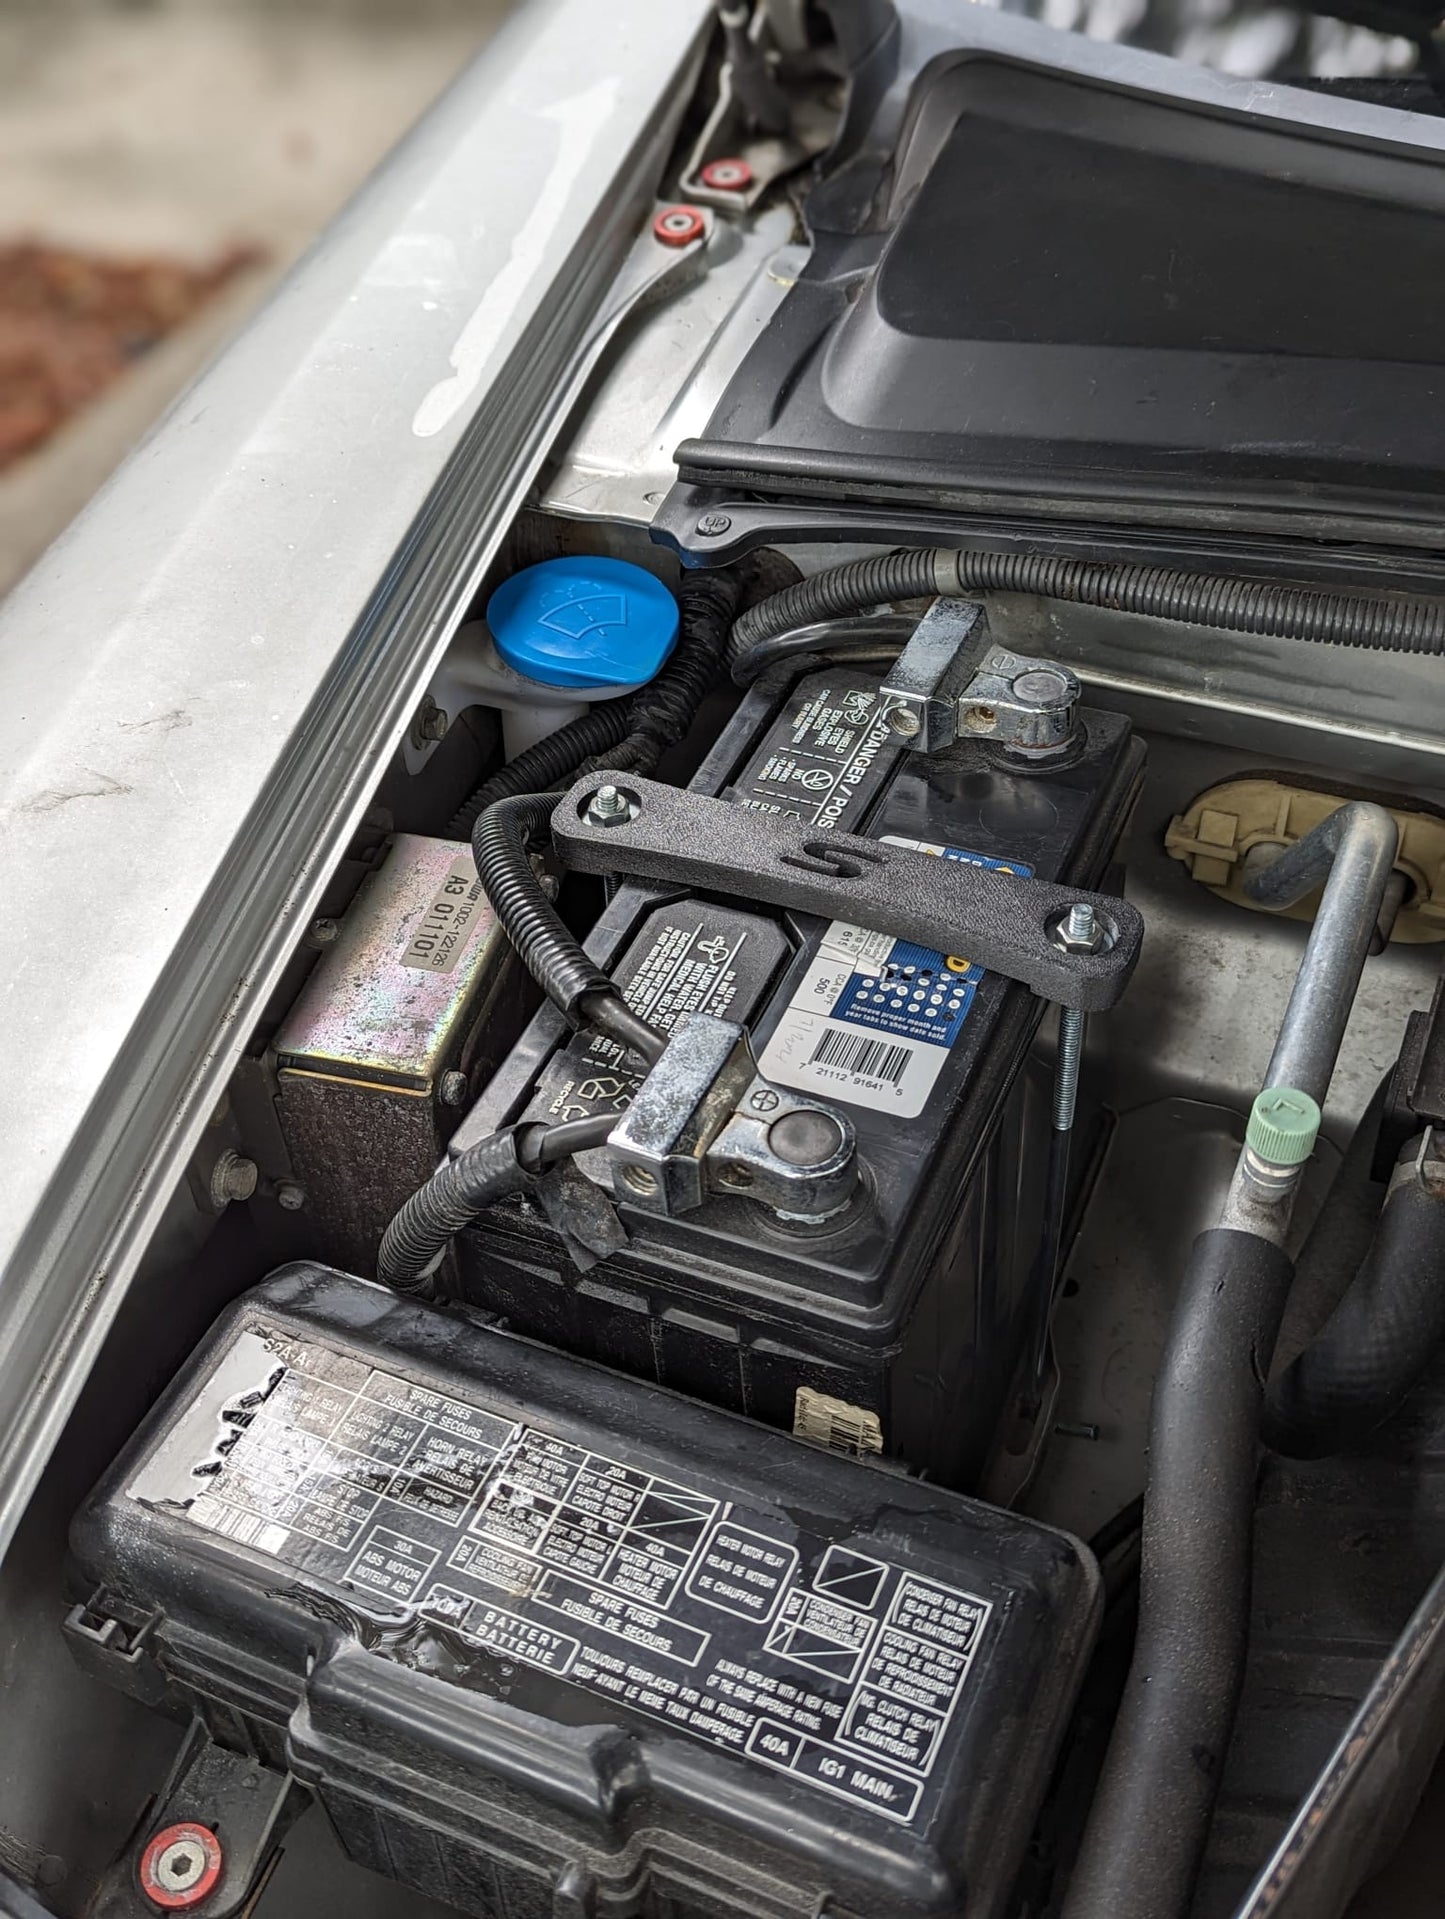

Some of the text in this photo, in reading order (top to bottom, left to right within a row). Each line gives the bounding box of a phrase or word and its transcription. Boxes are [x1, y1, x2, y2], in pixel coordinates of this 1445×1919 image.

[812, 707, 830, 730] GASES
[814, 709, 842, 746] EXPLOSIVE
[828, 727, 842, 745] EYES
[834, 729, 854, 754] SHIELD
[791, 768, 803, 779] NO
[818, 729, 883, 829] DANGER / POIS
[409, 875, 468, 957] A3 011101
[668, 959, 695, 991] MEDICAL
[686, 962, 707, 982] WITH
[695, 965, 719, 990] FLUSH
[813, 978, 829, 993] 500
[654, 993, 675, 1012] HELP
[684, 991, 703, 1009] EYES
[658, 1014, 676, 1028] GET
[844, 1009, 862, 1019] year
[862, 1014, 879, 1023] tabs
[888, 1020, 908, 1030] show
[909, 1026, 925, 1035] date
[850, 1004, 945, 1033] Remove proper month and
[815, 1068, 847, 1080] 21112
[853, 1078, 883, 1090] 91641
[894, 1088, 904, 1096] 5
[384, 1395, 483, 1438] FUSIBLE SECOURS
[409, 1390, 471, 1419] SPARE FUSES
[341, 1423, 370, 1440] RELAIS
[370, 1434, 397, 1451] LAMPE
[351, 1411, 414, 1441] LIGHTING RELAY
[424, 1450, 457, 1469] RELAIS
[427, 1437, 487, 1466] HORN RELAY
[411, 1459, 474, 1490] AVERTISSEUR
[541, 1458, 567, 1474] MOTOR
[607, 1466, 627, 1479] 20A
[336, 1484, 360, 1499] STOP
[390, 1478, 405, 1494] 10A
[423, 1487, 453, 1504] HAZARD
[576, 1484, 632, 1511] ELECTRO MOTEUR
[578, 1472, 634, 1499] SOFT TOP MOTOR
[303, 1513, 334, 1530] RELAIS
[314, 1507, 332, 1519] ABS
[571, 1495, 625, 1522] CAPOTE DROIT
[303, 1523, 321, 1535] ABS
[550, 1523, 607, 1551] SOFT TOP MOTOR
[580, 1517, 600, 1530] 20A
[393, 1540, 413, 1554] 30A
[455, 1544, 472, 1563] 20A
[481, 1548, 514, 1566] COOLING
[542, 1546, 597, 1574] CAPOTE GAUCHE
[547, 1535, 604, 1564] ELECTRO MOTEUR
[644, 1542, 666, 1556] 40A
[716, 1534, 785, 1568] HEATER MOTOR RELAY
[362, 1550, 421, 1581] ABS MOTOR
[617, 1549, 677, 1579] HEATER MOTOR
[618, 1563, 665, 1589] MOTEUR DE
[705, 1554, 776, 1588] RELAIS DE MOTEUR
[354, 1564, 411, 1595] MOTEUR ABS
[612, 1574, 659, 1600] CHAUFFAGE
[698, 1575, 764, 1608] DE CHAUFFAGE
[588, 1592, 659, 1628] SPARE FUSES
[805, 1608, 853, 1633] VENTILATEUR
[903, 1598, 971, 1633] RELAIS MOTEUR
[484, 1610, 561, 1651] BATTERY
[560, 1598, 672, 1651] FUSIBLE DE SECOURS
[476, 1623, 554, 1664] BATTERIE
[883, 1631, 963, 1671] COOLING FAN RELAY
[880, 1645, 955, 1683] RELAIS MOTEUR
[579, 1645, 754, 1728] TOUJOURS REMPLACER PAR FUSIBLE
[715, 1657, 842, 1719] ALWAYS REPLACE WITH NEW FUSE
[884, 1662, 953, 1698] REFROIDISSEMENT
[892, 1680, 936, 1706] RADIATEUR
[664, 1701, 690, 1721] TAUX
[717, 1677, 793, 1719] THE SAME AMPERAGE
[877, 1699, 909, 1722] CLUTCH
[865, 1712, 920, 1744] RELAIS DE
[758, 1731, 791, 1756] 40A
[854, 1725, 918, 1761] CLIMATISEUR
[817, 1756, 893, 1800] IG1 MAIN
